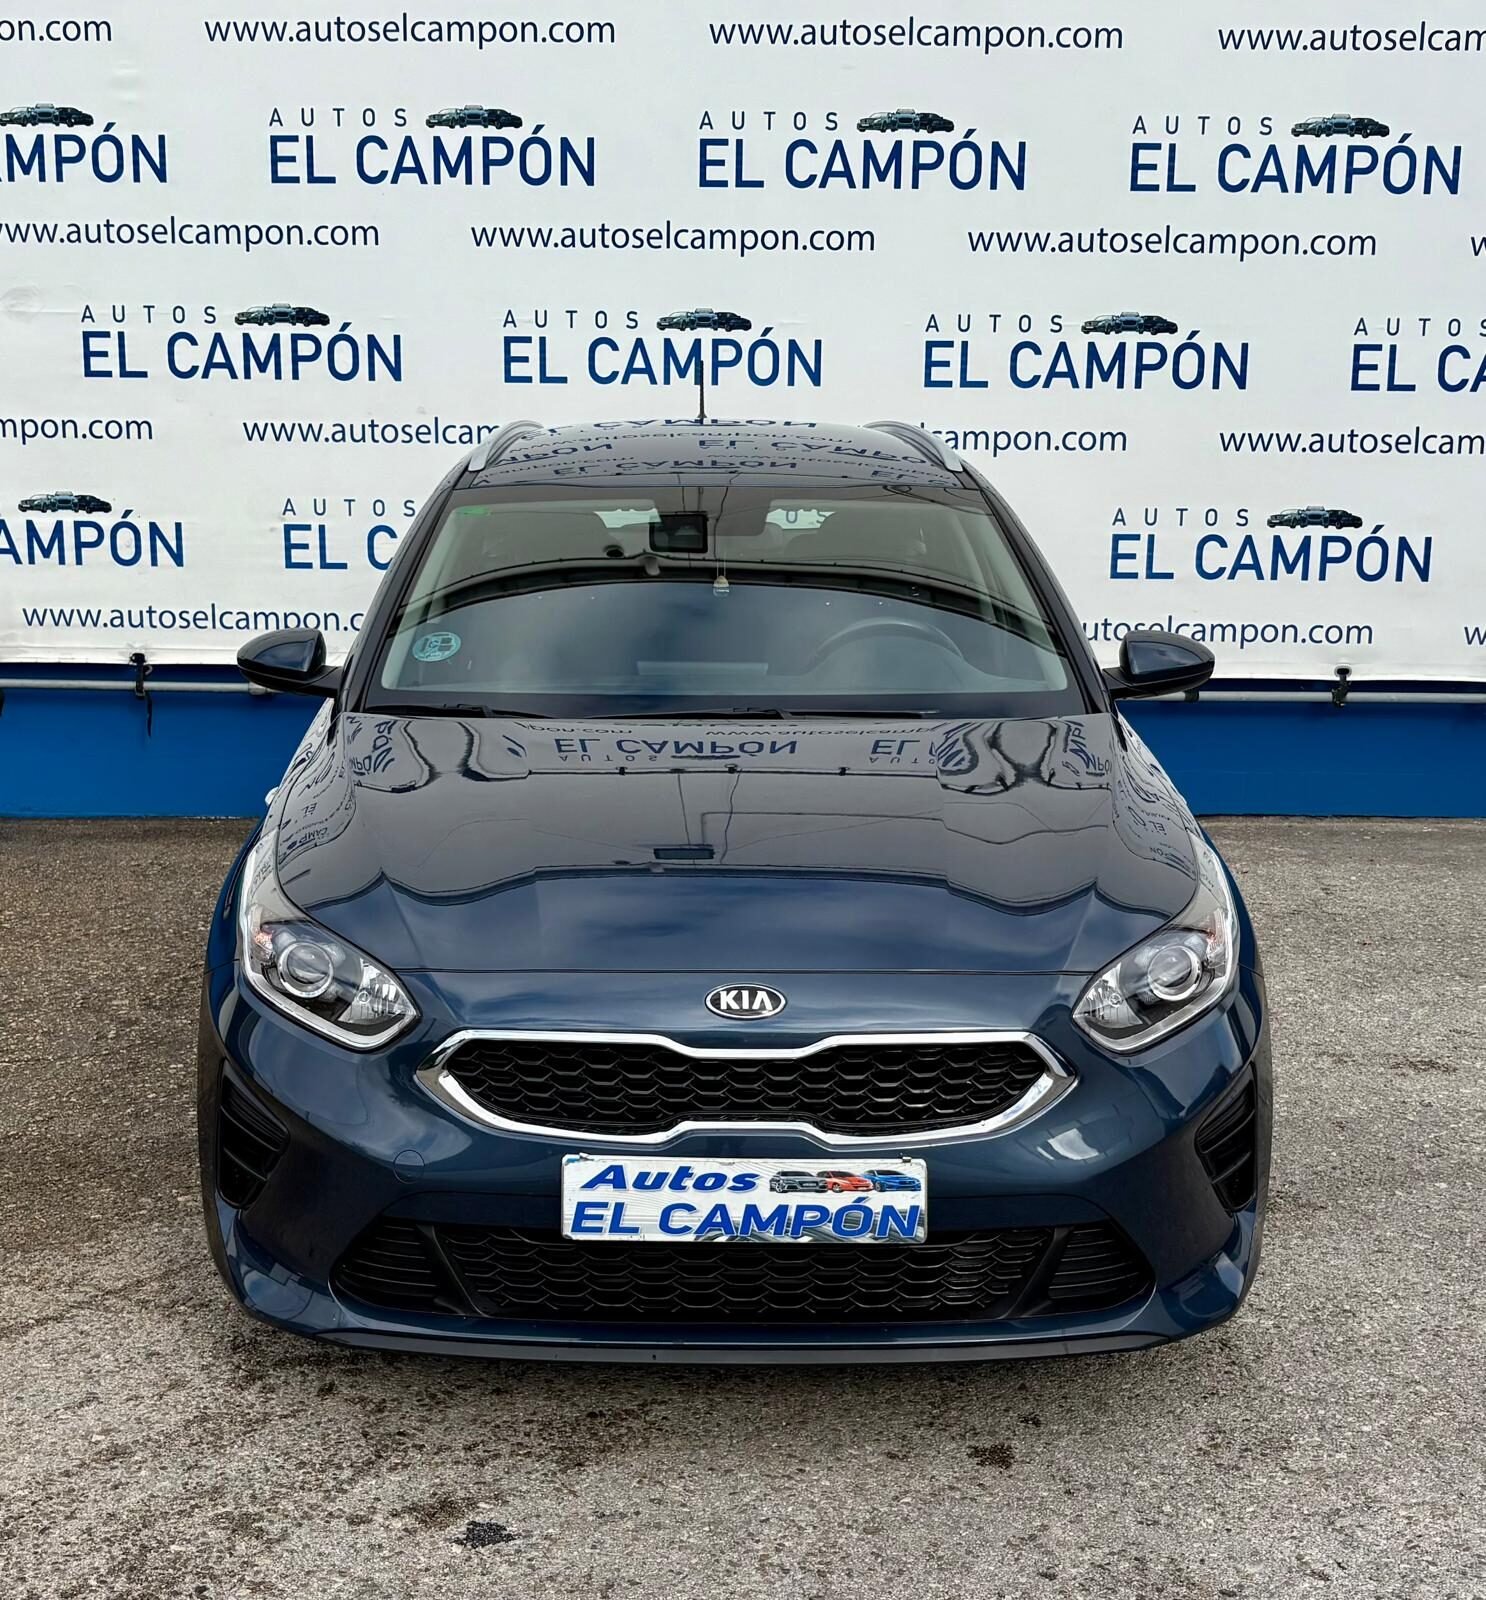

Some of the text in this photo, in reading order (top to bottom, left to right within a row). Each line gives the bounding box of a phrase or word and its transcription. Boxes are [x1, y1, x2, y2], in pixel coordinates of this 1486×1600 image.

[204, 12, 615, 50] www.autoselcampon.com
[709, 15, 1123, 55] www.autoselcampon.com
[269, 107, 409, 128] AUTOS
[698, 110, 838, 132] AUTOS
[1132, 115, 1273, 136] AUTOS
[0, 122, 168, 184] MPÓN
[269, 125, 595, 188] EL CAMPÓN
[698, 129, 1027, 191] EL CAMPÓN
[1130, 133, 1462, 196] EL CAMPÓN
[0, 215, 379, 253] ww.autoselcampon.com
[470, 219, 875, 258] www.autoselcampon.com
[967, 224, 1376, 263] www.autoselcampon.com
[80, 304, 217, 325] AUTOS
[502, 309, 639, 330] AUTOS
[925, 313, 1064, 334] AUTOS
[81, 322, 402, 382] EL CAMPÓN
[503, 326, 823, 388] EL CAMPÓN
[923, 330, 1249, 390] EL CAMPÓN
[1350, 343, 1417, 392] EL
[282, 497, 419, 518] AUTOS
[1111, 507, 1249, 528] AUTOS
[283, 523, 348, 570] EL
[1109, 524, 1433, 584] EL CAMPÓN
[719, 989, 773, 1012] KIA
[580, 1164, 760, 1193] Autos
[570, 1196, 922, 1239] EL CAMPÓN
